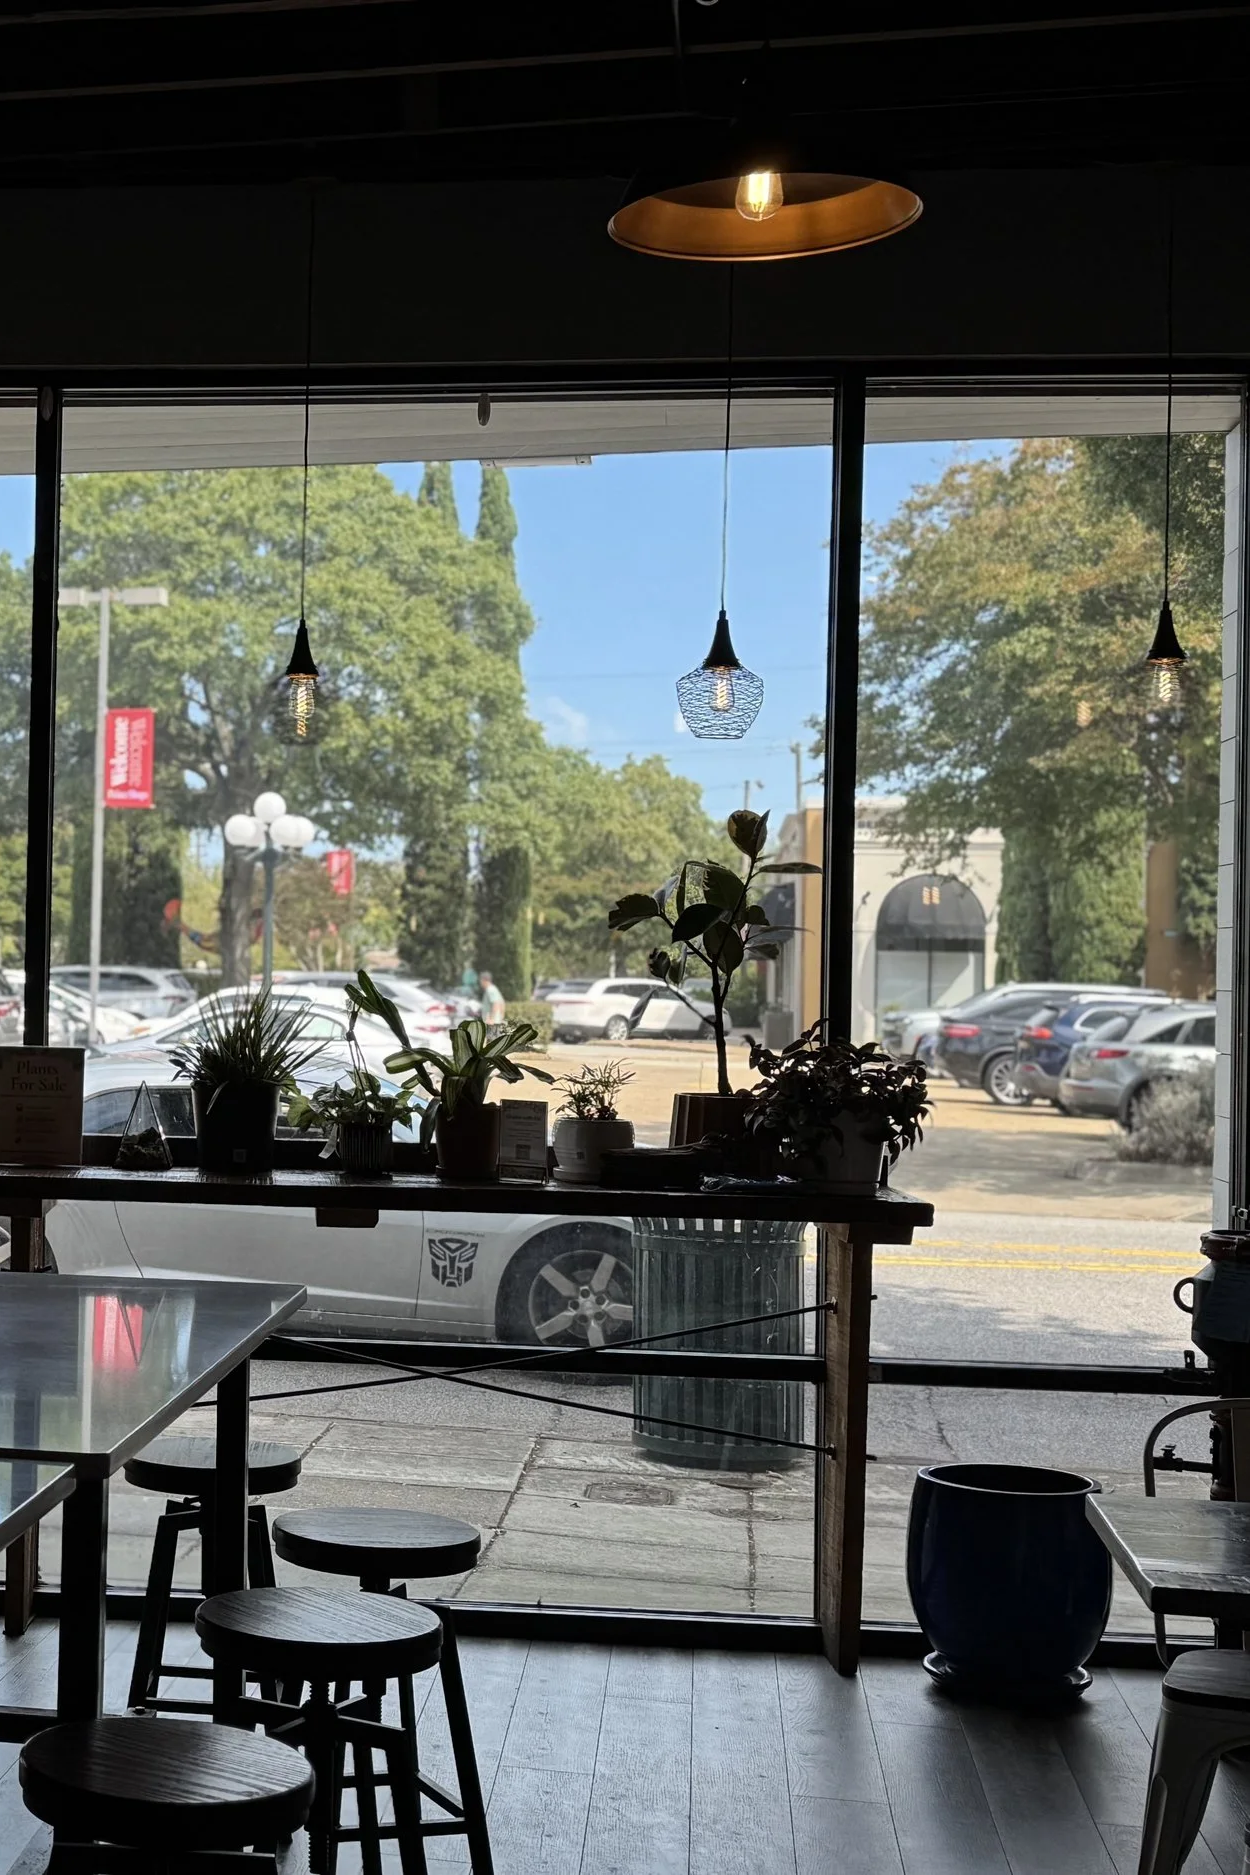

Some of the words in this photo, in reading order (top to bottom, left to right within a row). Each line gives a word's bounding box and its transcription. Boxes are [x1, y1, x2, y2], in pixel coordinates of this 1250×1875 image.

[16, 1060, 59, 1075] Plants
[11, 1077, 33, 1091] For
[38, 1077, 67, 1092] Sale
